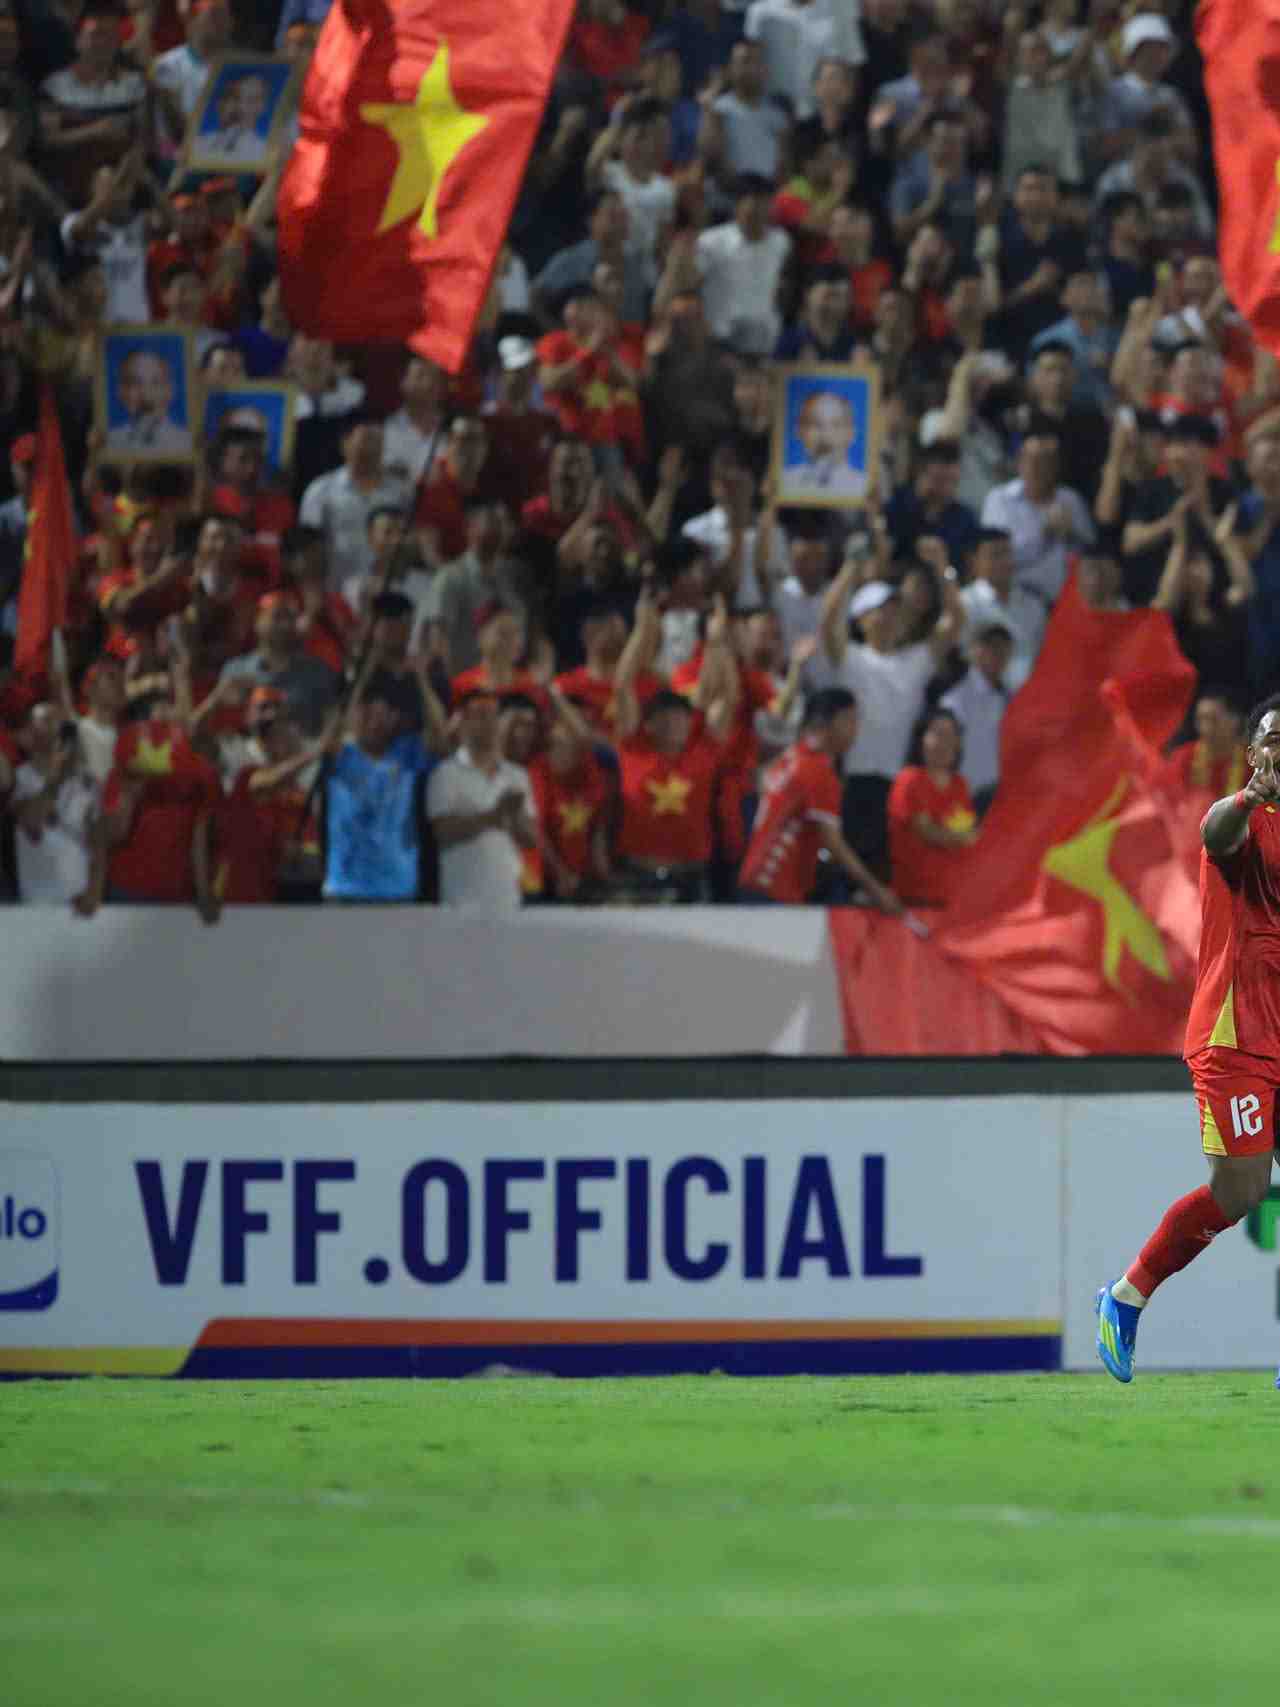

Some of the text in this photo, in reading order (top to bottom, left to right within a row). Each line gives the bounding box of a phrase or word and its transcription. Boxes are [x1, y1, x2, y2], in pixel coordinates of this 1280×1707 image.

[1231, 1094, 1263, 1138] 12
[0, 1195, 47, 1239] lo
[135, 1155, 923, 1286] VFF.OFFICIAL
